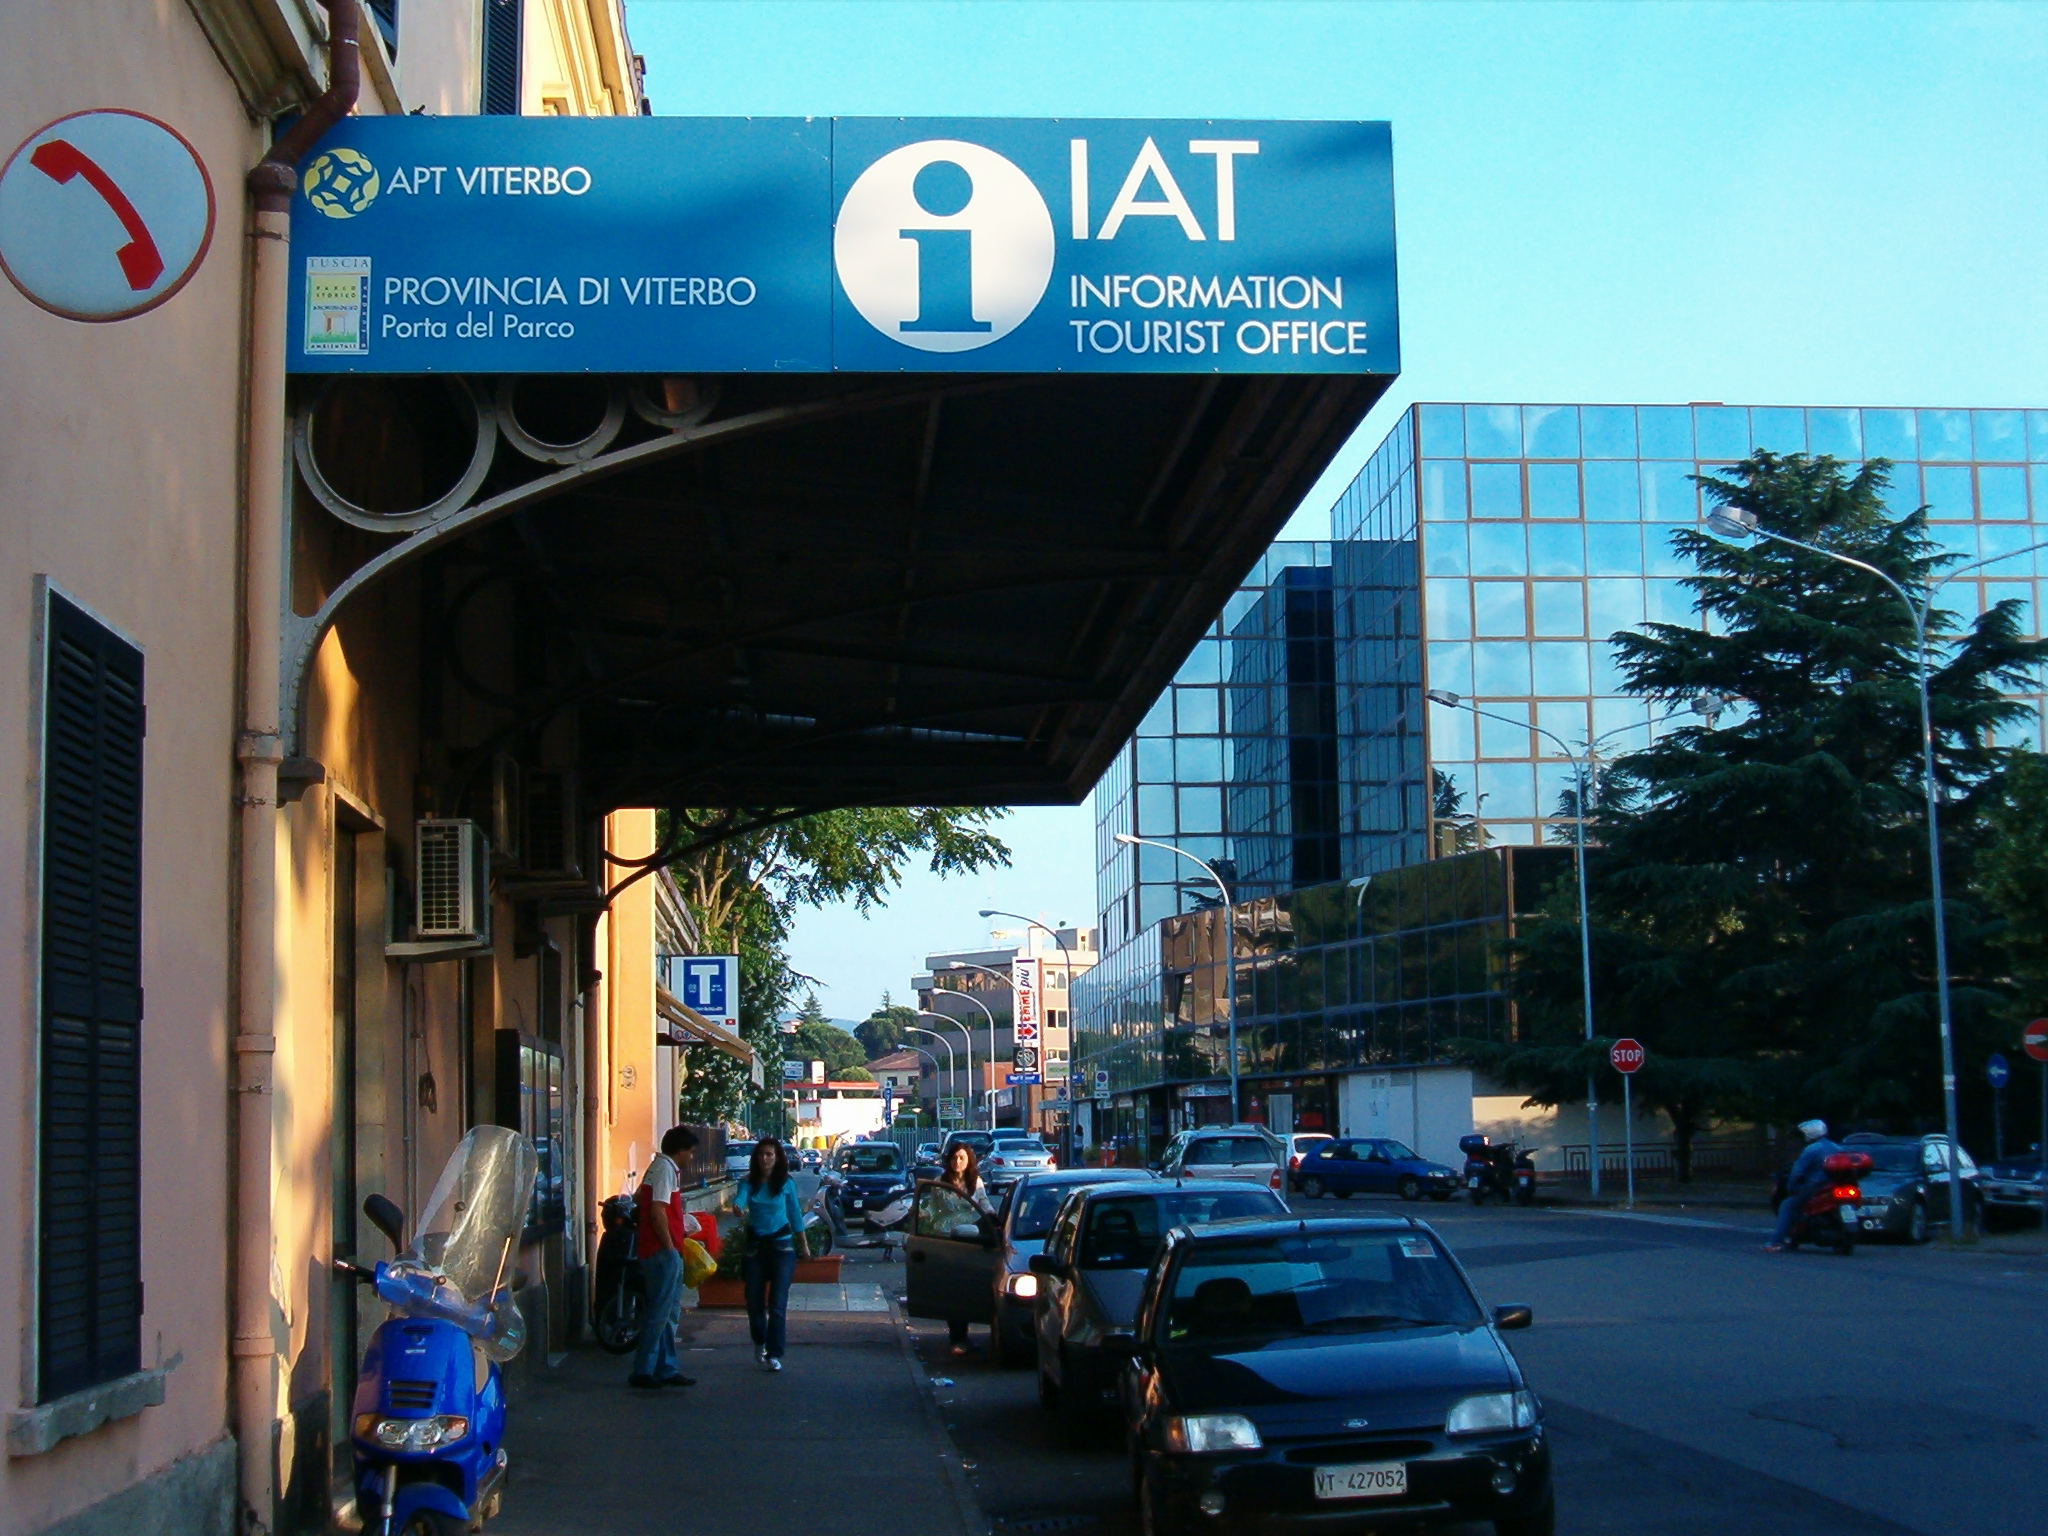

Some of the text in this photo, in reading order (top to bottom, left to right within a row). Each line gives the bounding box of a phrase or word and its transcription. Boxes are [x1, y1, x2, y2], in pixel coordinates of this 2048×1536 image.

[386, 166, 592, 196] APT VITERBO
[1070, 136, 1260, 241] IAT
[308, 258, 369, 268] TUSCIA
[384, 276, 757, 306] PROVINCIA DI VITERBO
[1069, 275, 1343, 310] INFORMATION
[381, 313, 447, 339] Porta
[456, 312, 494, 339] del
[503, 314, 575, 339] Parco
[1069, 321, 1368, 355] TOURIST OFFICE
[690, 964, 720, 1005] T
[1612, 1049, 1642, 1063] STOP
[1316, 1469, 1404, 1492] VT 427052
